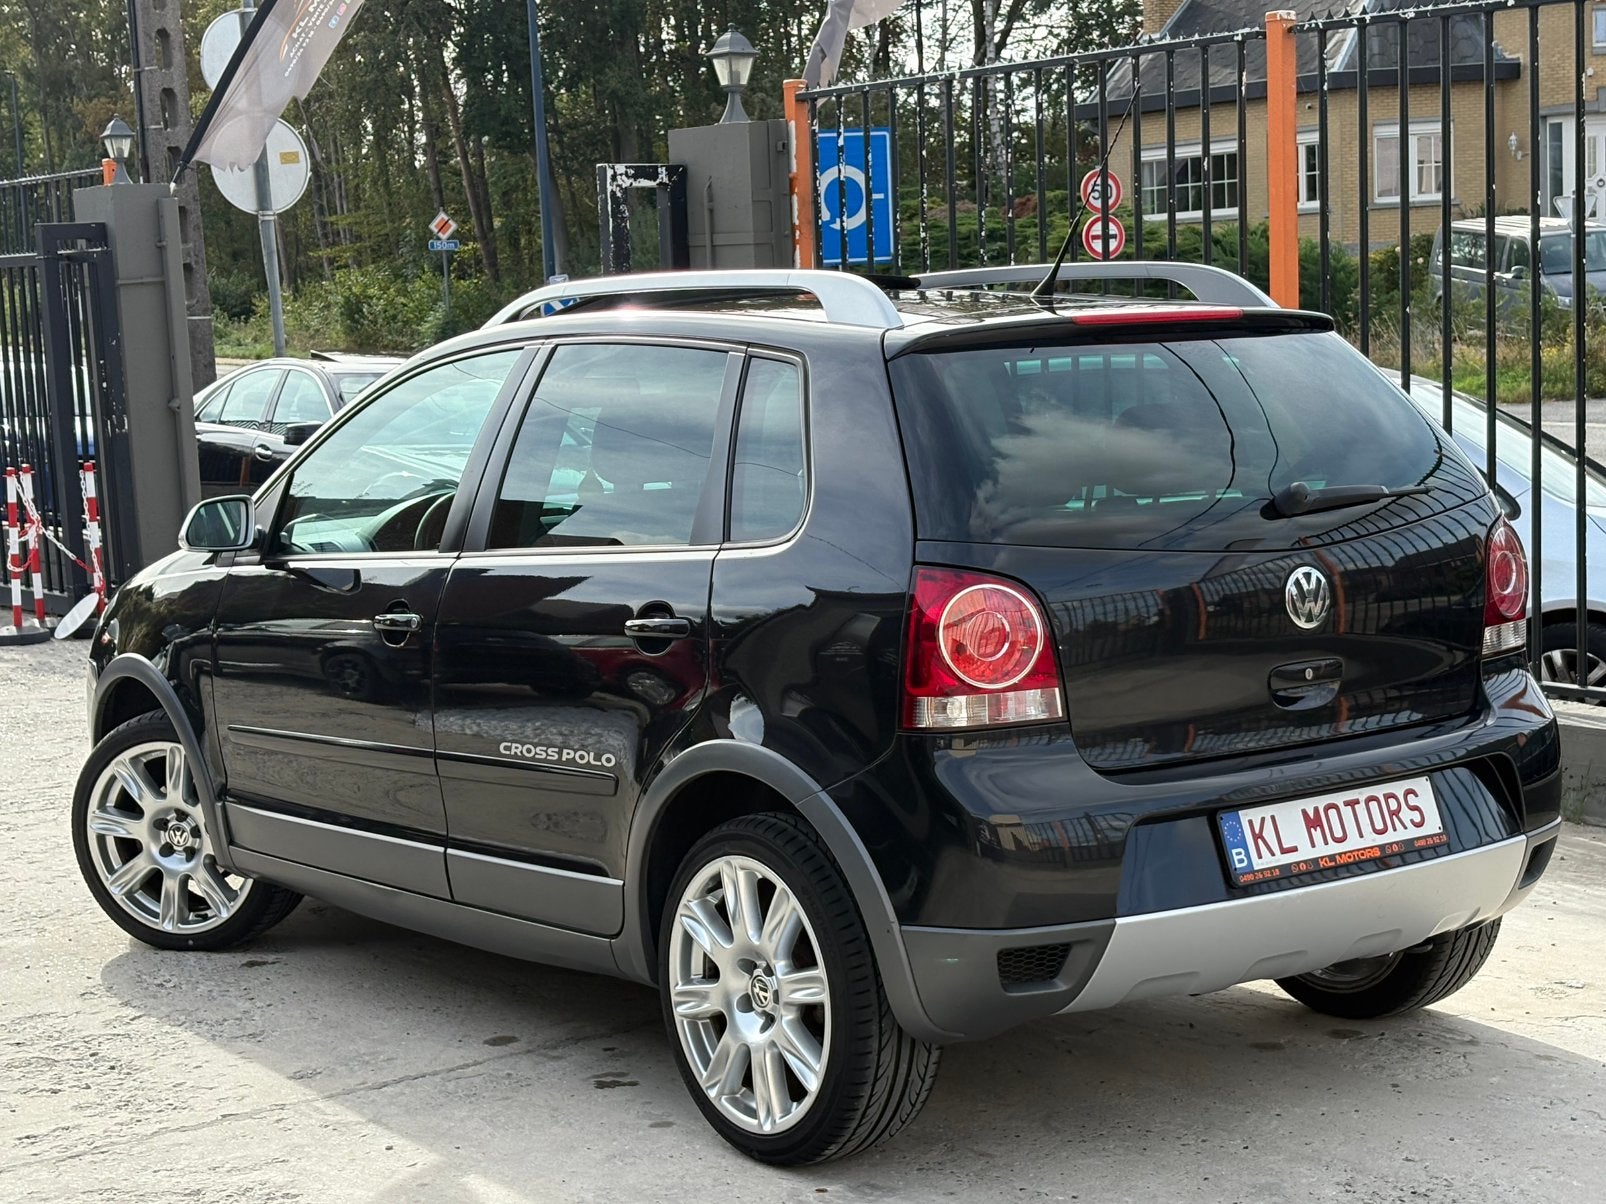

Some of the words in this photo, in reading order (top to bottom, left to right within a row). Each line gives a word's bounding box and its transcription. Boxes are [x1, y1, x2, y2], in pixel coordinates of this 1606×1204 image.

[307, 4, 324, 26] VENTE
[292, 17, 309, 38] KL
[499, 742, 559, 760] CROSS
[562, 748, 616, 767] POLO
[1247, 814, 1299, 860] KL
[1300, 788, 1426, 849] MOTORS
[1231, 848, 1248, 868] B
[1318, 857, 1335, 868] KL
[1336, 847, 1381, 864] MOTORS
